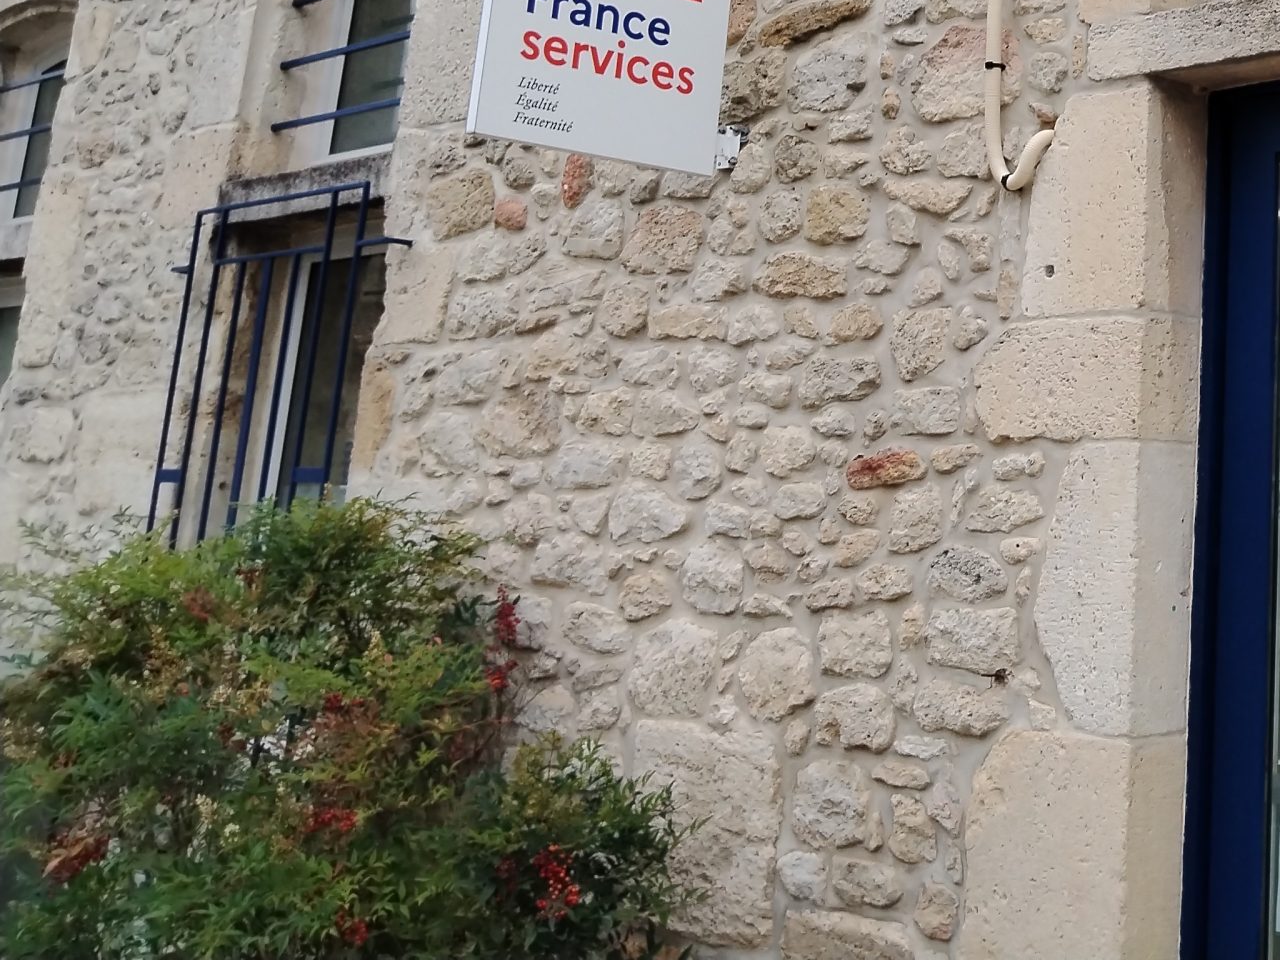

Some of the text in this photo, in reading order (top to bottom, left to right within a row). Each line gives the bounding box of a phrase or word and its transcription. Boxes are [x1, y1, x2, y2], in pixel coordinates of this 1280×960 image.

[520, 30, 695, 95] services
[517, 76, 561, 95] Liberté
[515, 91, 559, 112] Égalité
[513, 111, 574, 133] Fraternité
